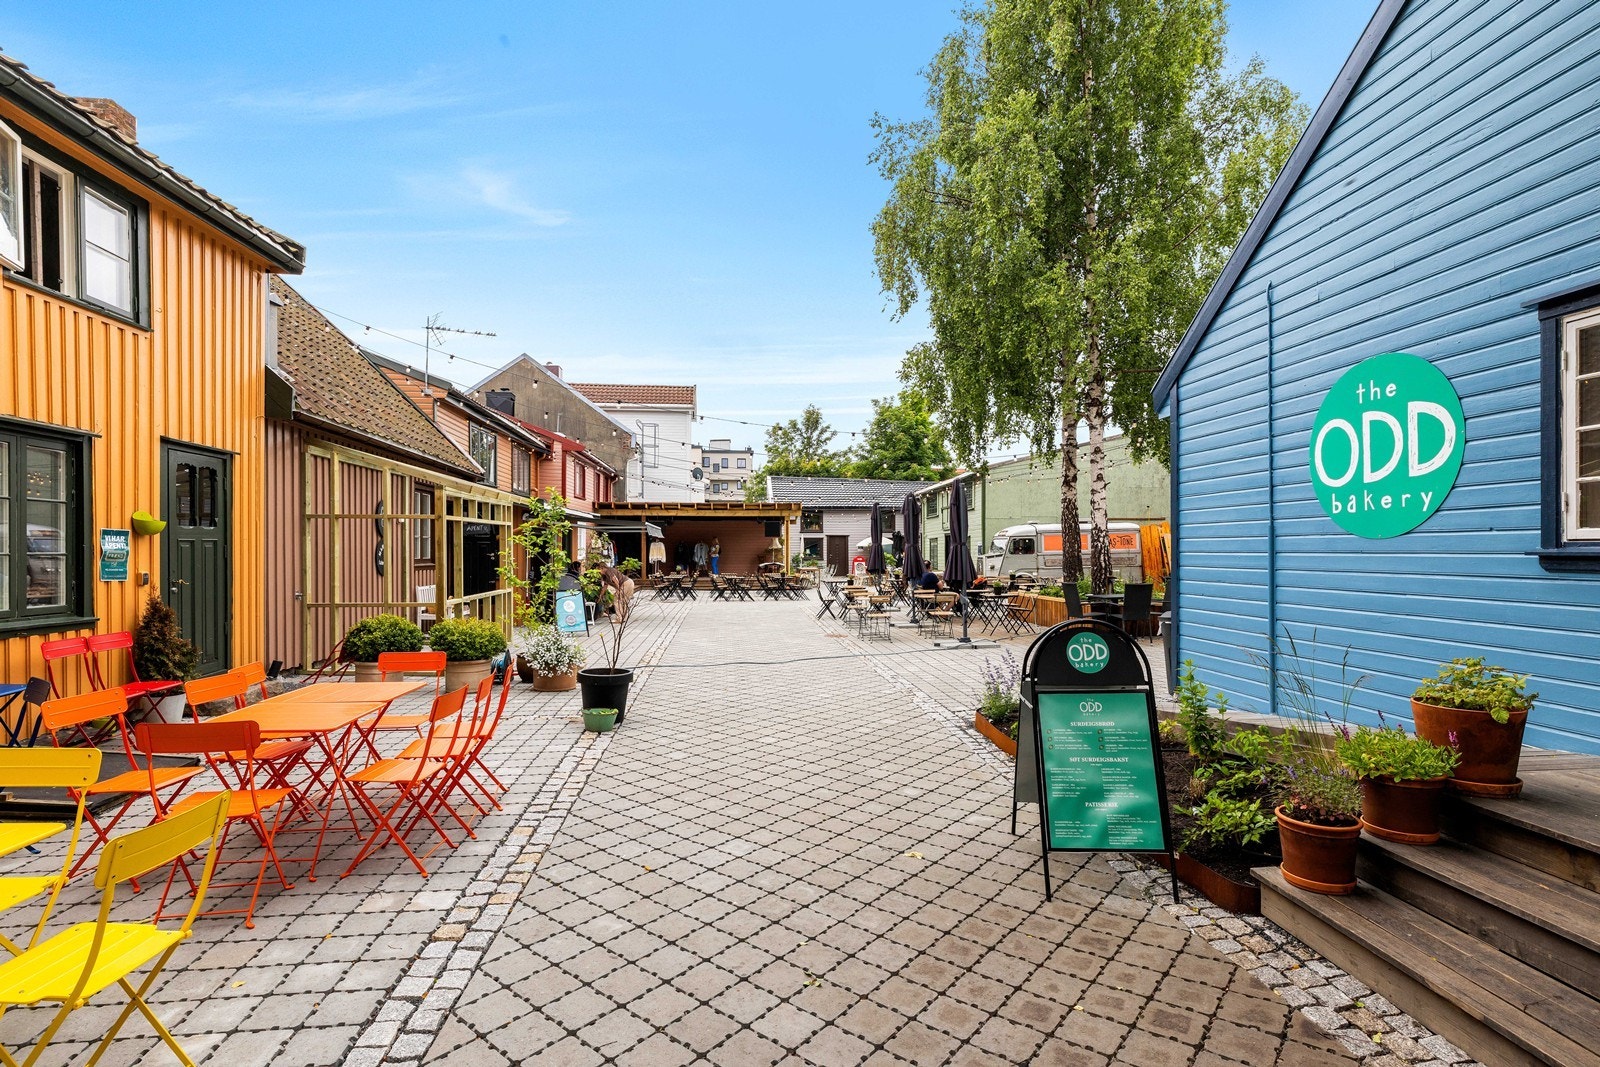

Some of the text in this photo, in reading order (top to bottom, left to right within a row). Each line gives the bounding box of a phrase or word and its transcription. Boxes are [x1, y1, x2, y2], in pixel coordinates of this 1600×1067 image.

[1356, 379, 1397, 404] the
[1314, 401, 1457, 488] ODD
[1331, 489, 1433, 514] bakery
[1109, 535, 1134, 548] AS-TONE
[1068, 643, 1108, 662] ODD
[1079, 702, 1103, 713] ODD
